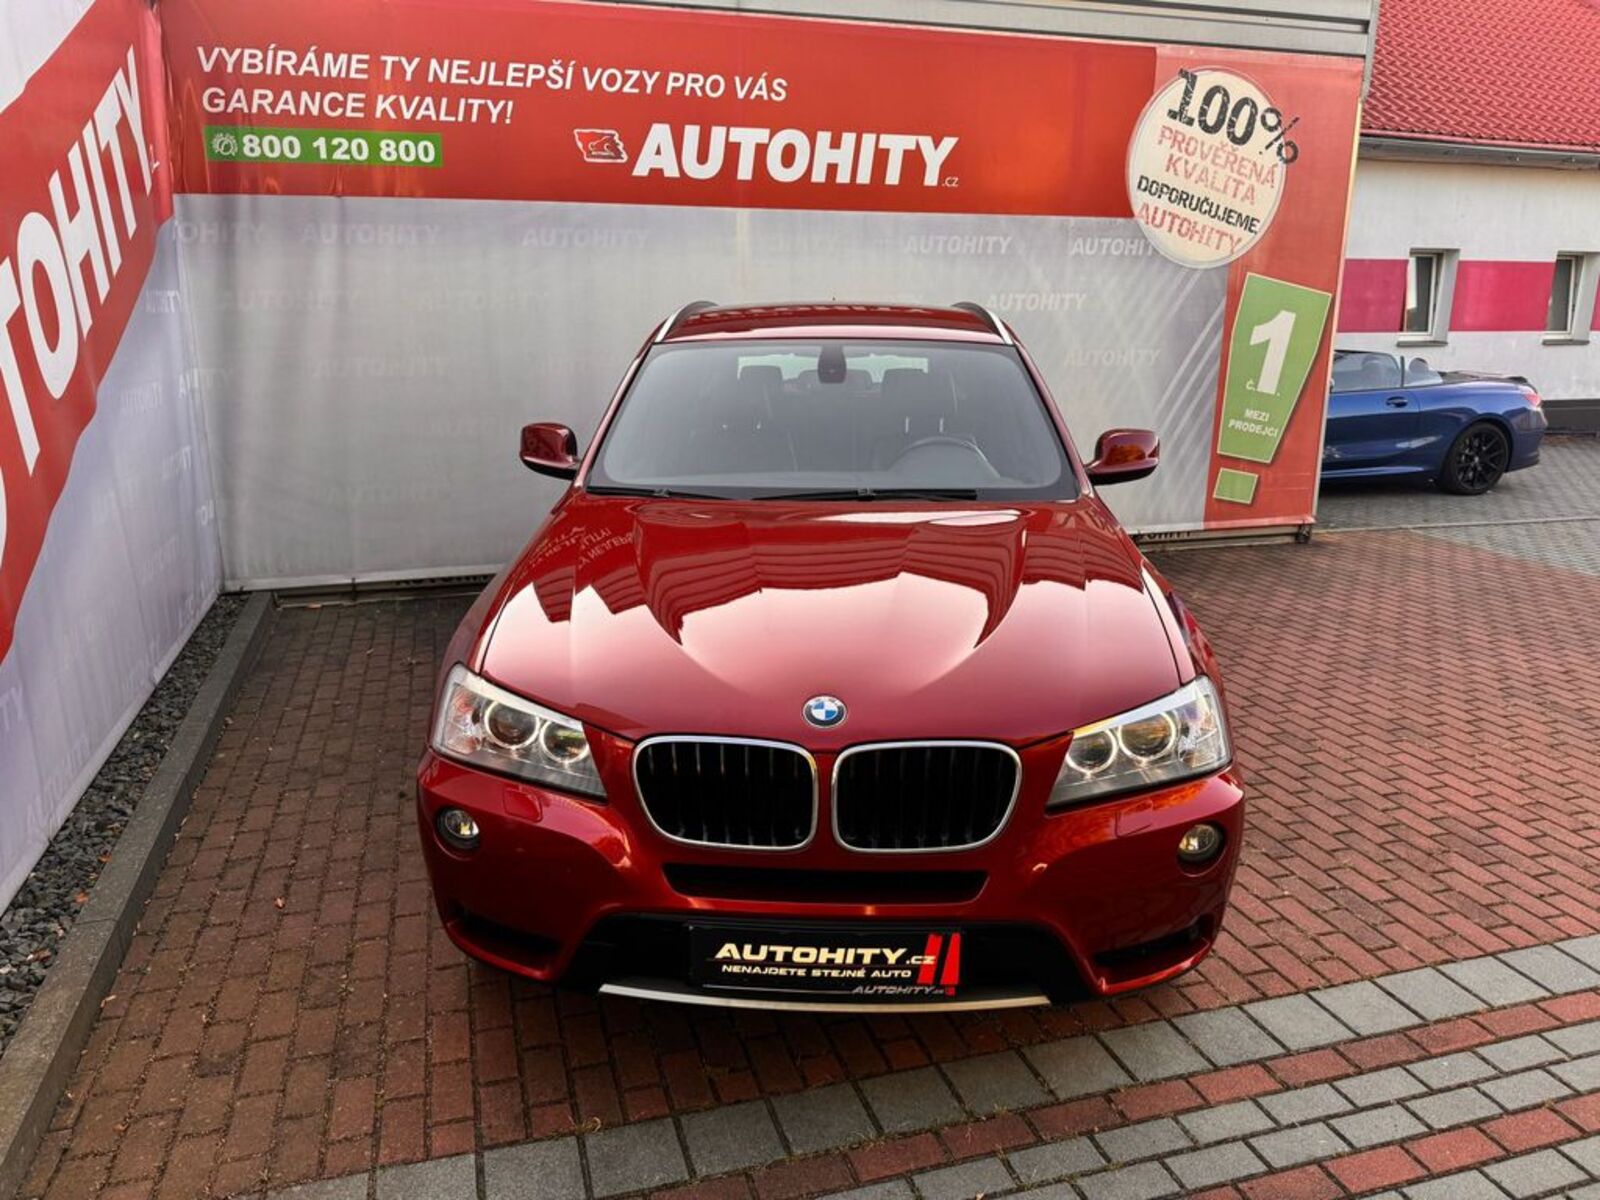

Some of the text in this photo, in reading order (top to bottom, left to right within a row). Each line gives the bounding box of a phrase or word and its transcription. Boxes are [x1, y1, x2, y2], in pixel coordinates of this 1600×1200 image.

[197, 43, 788, 102] VYBÍRÁME TY NEJLEPŠÍ VOZY PRO VÁS
[202, 87, 513, 125] GARANCE KVALITY!
[1167, 68, 1300, 164] 100%
[242, 135, 435, 163] 800 120 800
[1158, 125, 1279, 188] PROVĚŘENÁ
[1165, 154, 1256, 205] KVALITA
[1136, 175, 1261, 235] DOPORUČUJEME
[301, 223, 441, 246] AUTOHITY
[521, 227, 651, 249] AUTOHITY
[1137, 202, 1243, 256] AUTOHITY
[903, 234, 1013, 256] AUTOHITY
[0, 45, 153, 570] TOHITY
[986, 292, 1088, 312] AUTOHITY
[1063, 347, 1161, 369] AUTOHITY
[1228, 420, 1278, 437] PRODEJCI
[1245, 408, 1270, 422] MEZI
[722, 964, 912, 979] NENAJDETE STEJNÉ AUTO
